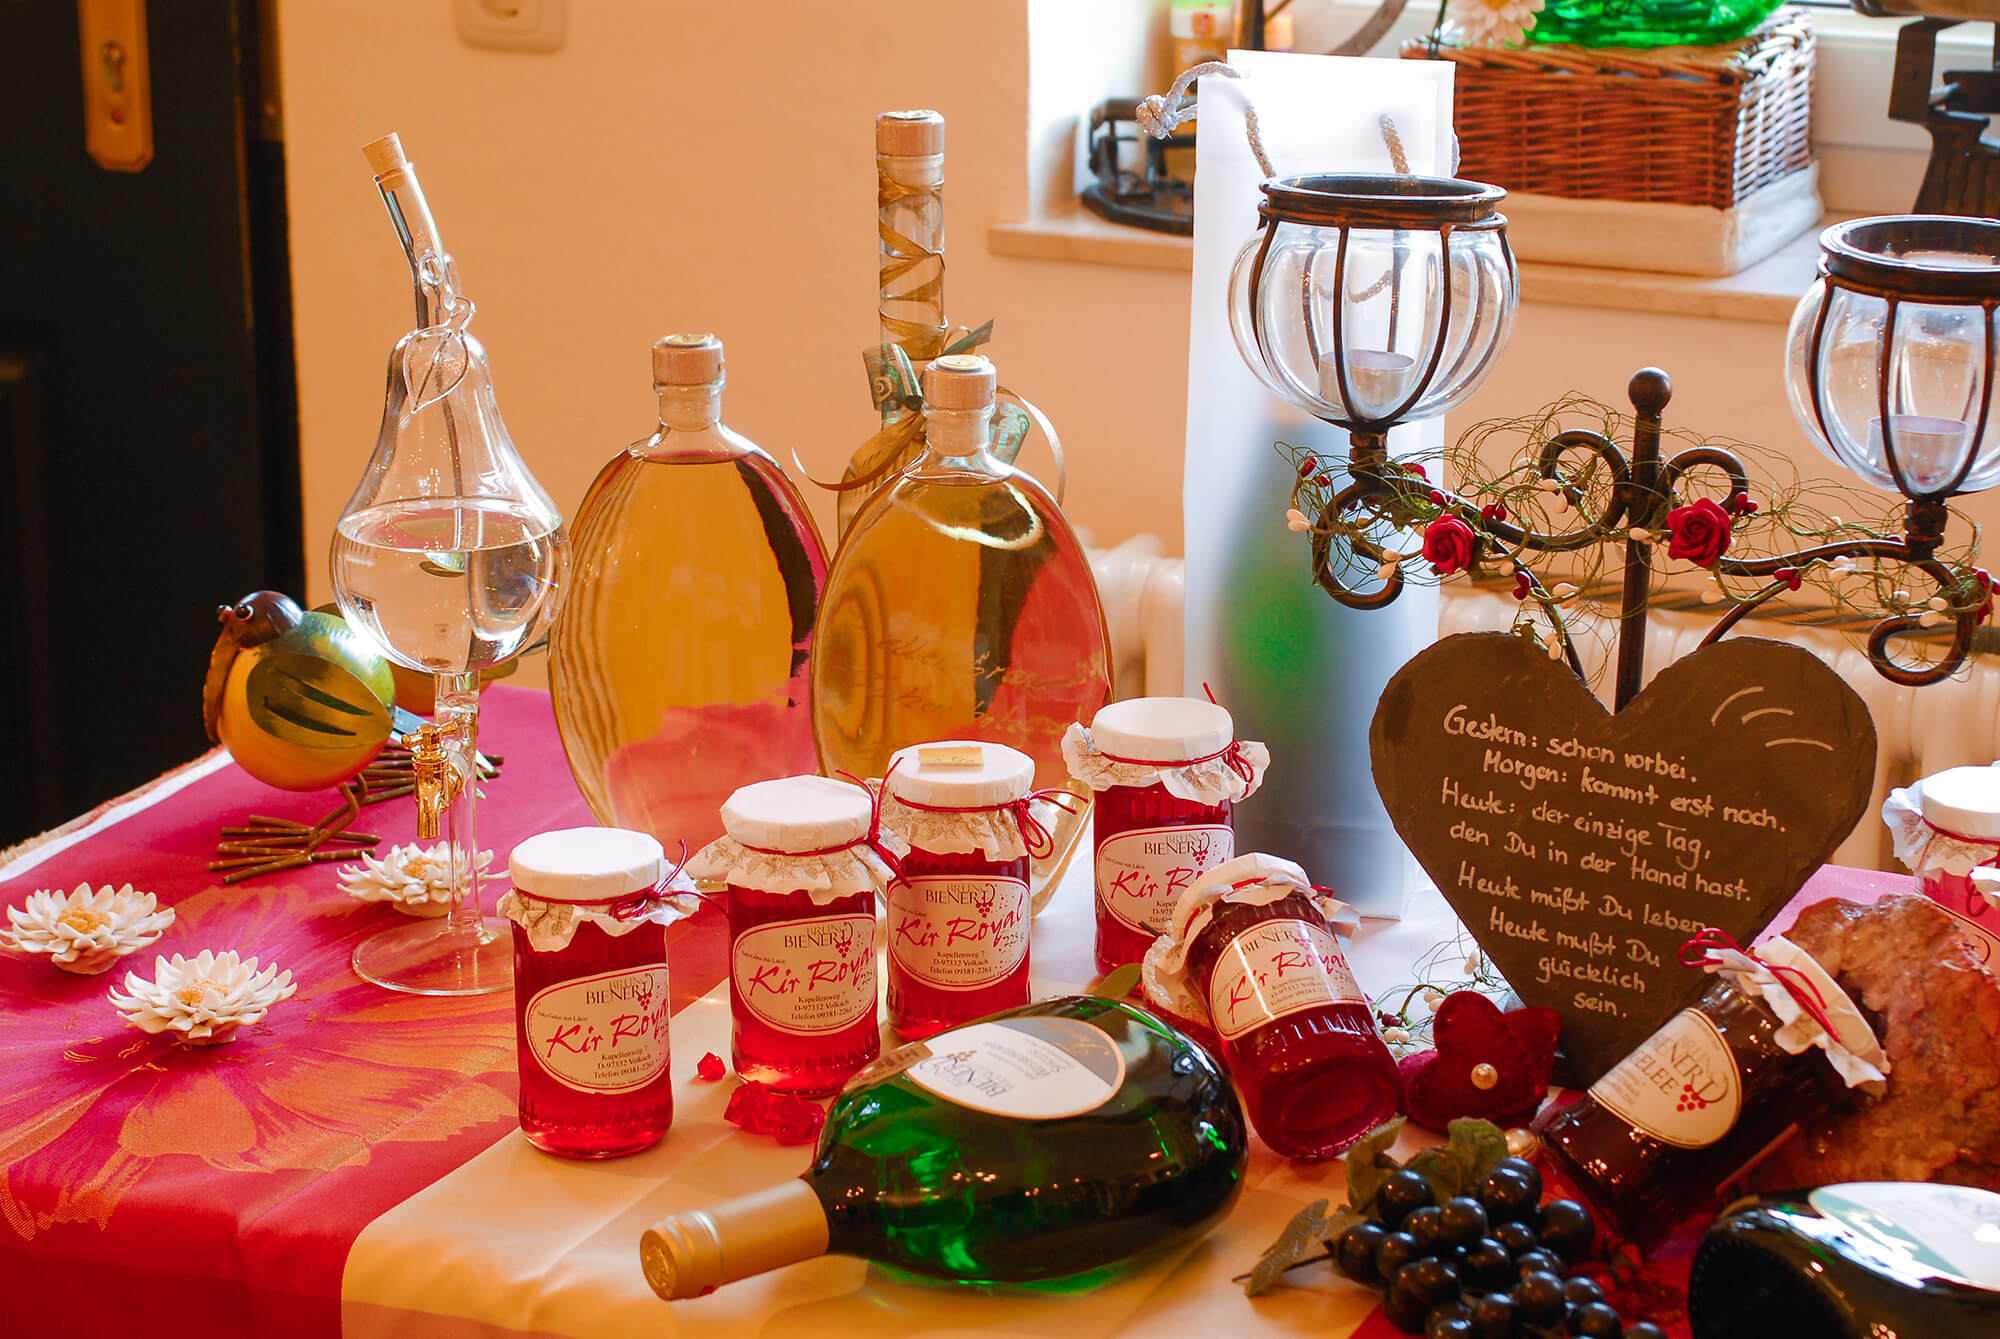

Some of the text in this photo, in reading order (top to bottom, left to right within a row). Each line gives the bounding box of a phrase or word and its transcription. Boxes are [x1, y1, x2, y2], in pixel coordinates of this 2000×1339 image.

[1443, 704, 1697, 783] Gestern: schon vorbei.
[1483, 749, 1786, 833] Morgen: kommt erst noch.
[1441, 776, 1711, 871] Heute: der einzige Tag,
[1110, 869, 1158, 900] Kir
[1450, 820, 1751, 901] den Du in der Hand hast.
[1458, 860, 1522, 899] Heute
[1598, 894, 1634, 921] Du
[896, 892, 1023, 947] Kir Royal
[1490, 905, 1549, 942] Heute
[1625, 938, 1661, 968] Du
[748, 928, 875, 997] Kir Royal
[1536, 956, 1646, 993] glücklich
[1573, 991, 1628, 1019] sein.
[546, 1024, 603, 1058] Kir
